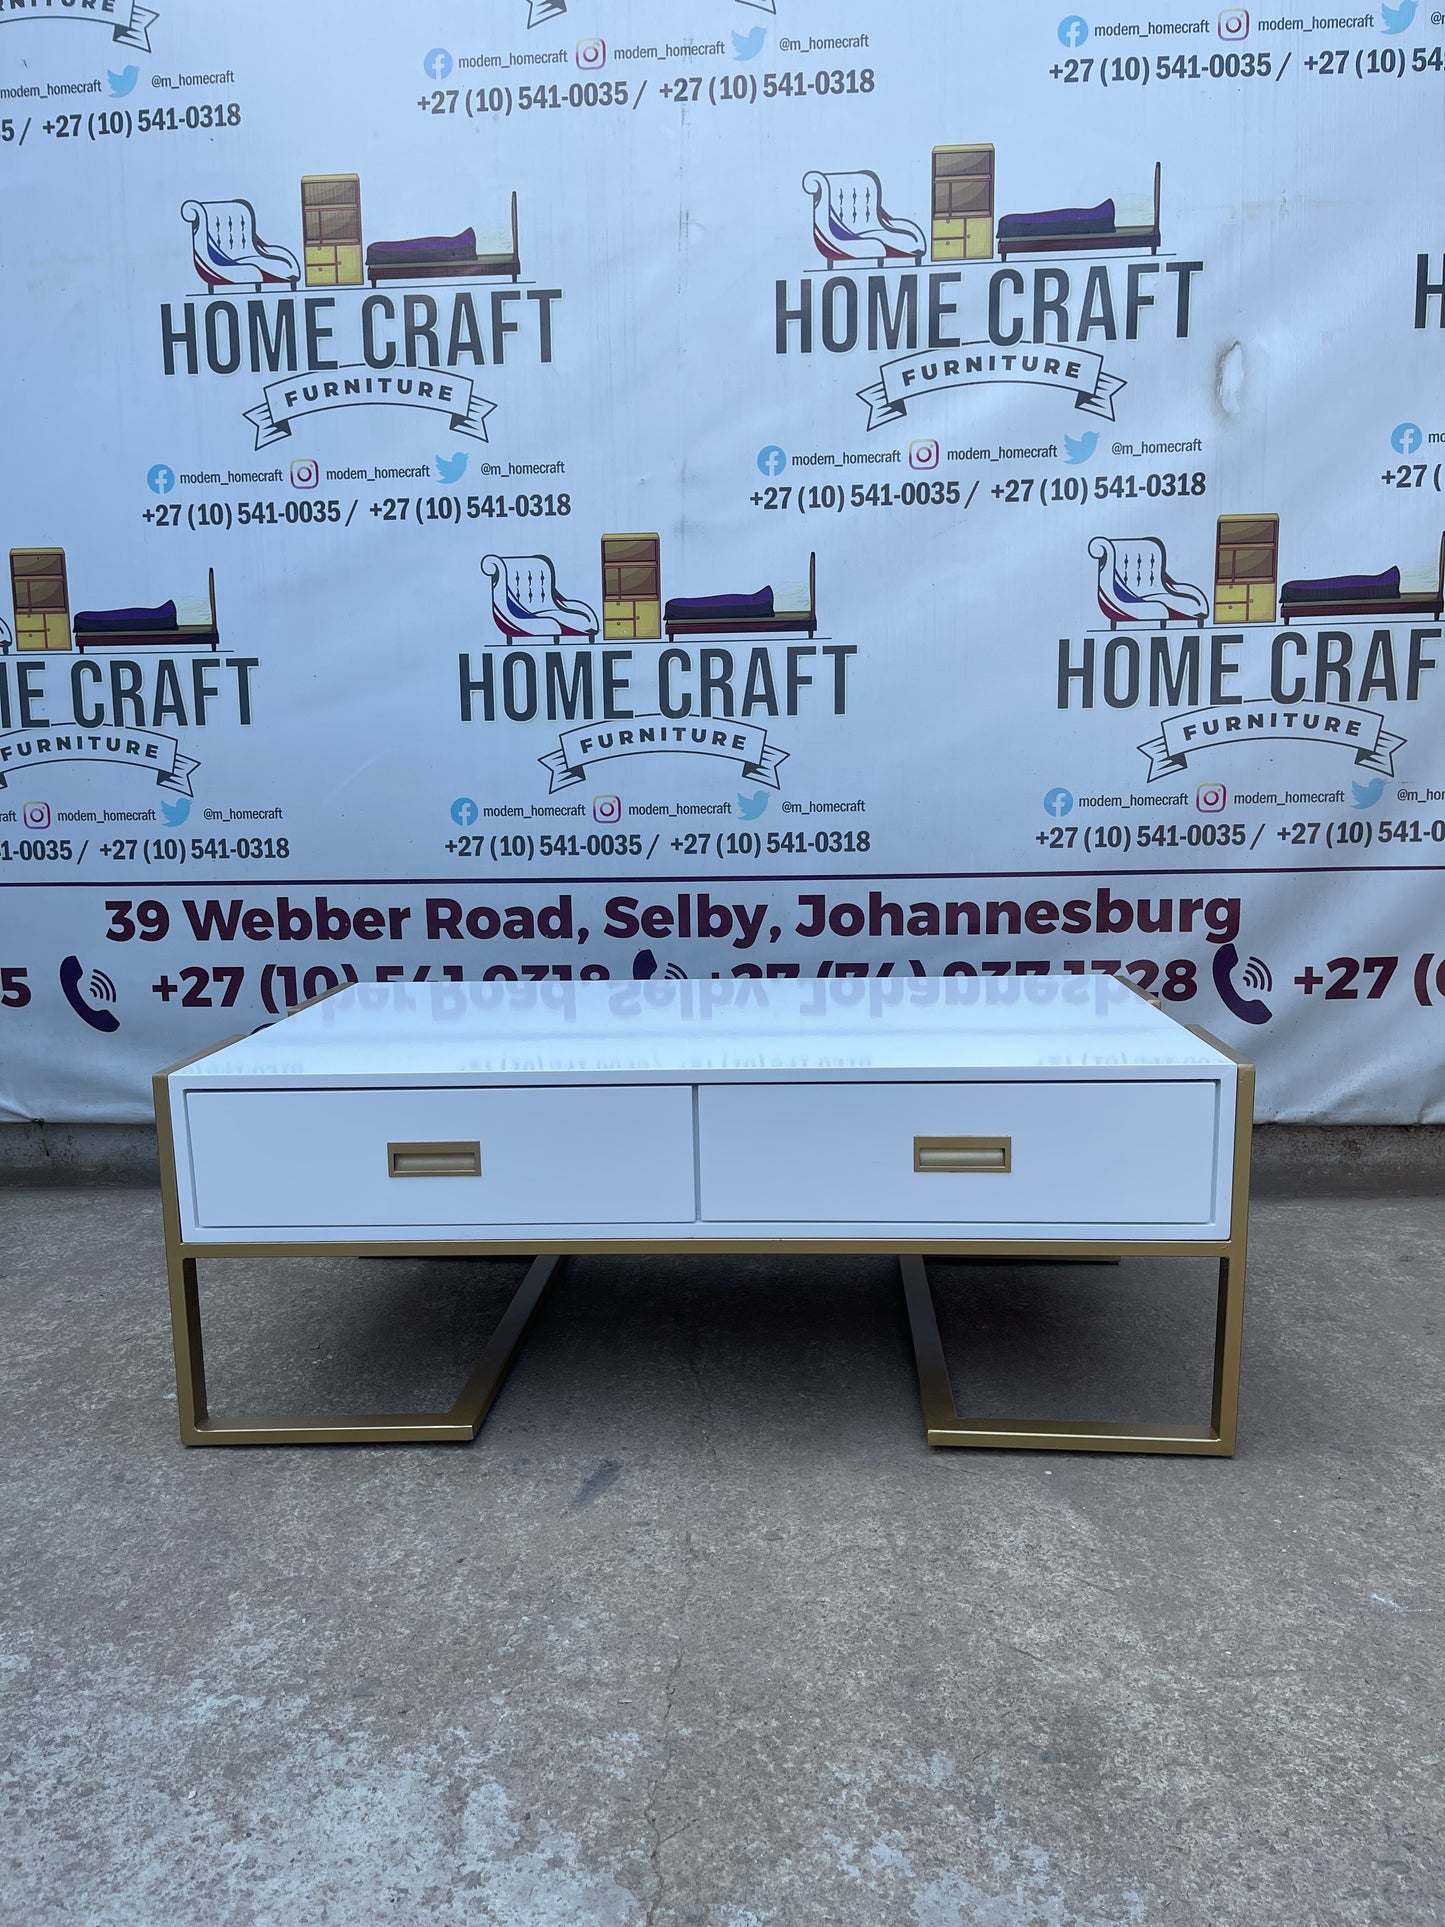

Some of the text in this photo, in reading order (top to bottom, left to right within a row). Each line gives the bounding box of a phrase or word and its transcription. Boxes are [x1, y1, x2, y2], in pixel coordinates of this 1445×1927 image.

[780, 34, 869, 53] @m_homecraft
[152, 70, 234, 89] @m_homecraft
[1049, 58, 1094, 83] +27
[1100, 57, 1149, 87] (10)
[1156, 52, 1271, 79] 541-0035
[1304, 50, 1349, 74] +27
[1356, 48, 1405, 79] (10)
[417, 90, 459, 114] +27
[466, 87, 512, 118] (10)
[518, 81, 628, 110] 541-0035
[659, 77, 702, 102] +27
[709, 75, 757, 105] (10)
[763, 69, 874, 97] 541-0318
[43, 114, 82, 138] +27
[88, 111, 132, 140] (10)
[138, 103, 241, 132] 541-0318
[776, 261, 1203, 354] HOME CRAFT
[161, 289, 562, 375] HOME CRAFT
[902, 355, 1081, 387] FURNITURE
[284, 378, 453, 407] FURNITURE
[1112, 438, 1202, 457] @m_homecraft
[481, 461, 565, 477] @m_homecraft
[1381, 464, 1427, 488] +27
[750, 487, 792, 509] +27
[798, 485, 844, 514] (10)
[850, 481, 960, 507] 541-0035
[991, 479, 1034, 502] +27
[1040, 477, 1088, 506] (10)
[1094, 472, 1206, 499] 541-0318
[142, 504, 182, 526] +27
[188, 503, 232, 531] (10)
[238, 500, 341, 524] 541-0035
[369, 498, 410, 520] +27
[416, 497, 461, 525] (10)
[467, 493, 571, 518] 541-0318
[459, 645, 857, 722] HOME CRAFT
[1058, 634, 1244, 709] HOME
[71, 658, 259, 729] CRAFT
[580, 727, 746, 754] FURNITURE
[1183, 713, 1361, 741] FURNITURE
[0, 736, 159, 762] FURNITURE
[204, 807, 283, 822] @m_homecraft
[782, 800, 866, 815] @m_homecraft
[100, 839, 138, 860] +27
[144, 839, 186, 864] (10)
[191, 838, 289, 859] 541-0318
[445, 836, 484, 856] +27
[490, 832, 534, 861] (10)
[539, 834, 642, 856] 541-0035
[671, 833, 711, 854] +27
[717, 833, 761, 859] (10)
[766, 831, 870, 853] 541-0318
[1036, 827, 1078, 848] +27
[1084, 826, 1131, 853] (10)
[1136, 824, 1246, 847] 541-0035
[1277, 823, 1321, 844] +27
[1326, 821, 1372, 849] (10)
[105, 888, 1239, 950] 39 Webber Road, Selby, Johannesburg
[152, 966, 244, 1007] +27
[1294, 956, 1398, 1000] +27
